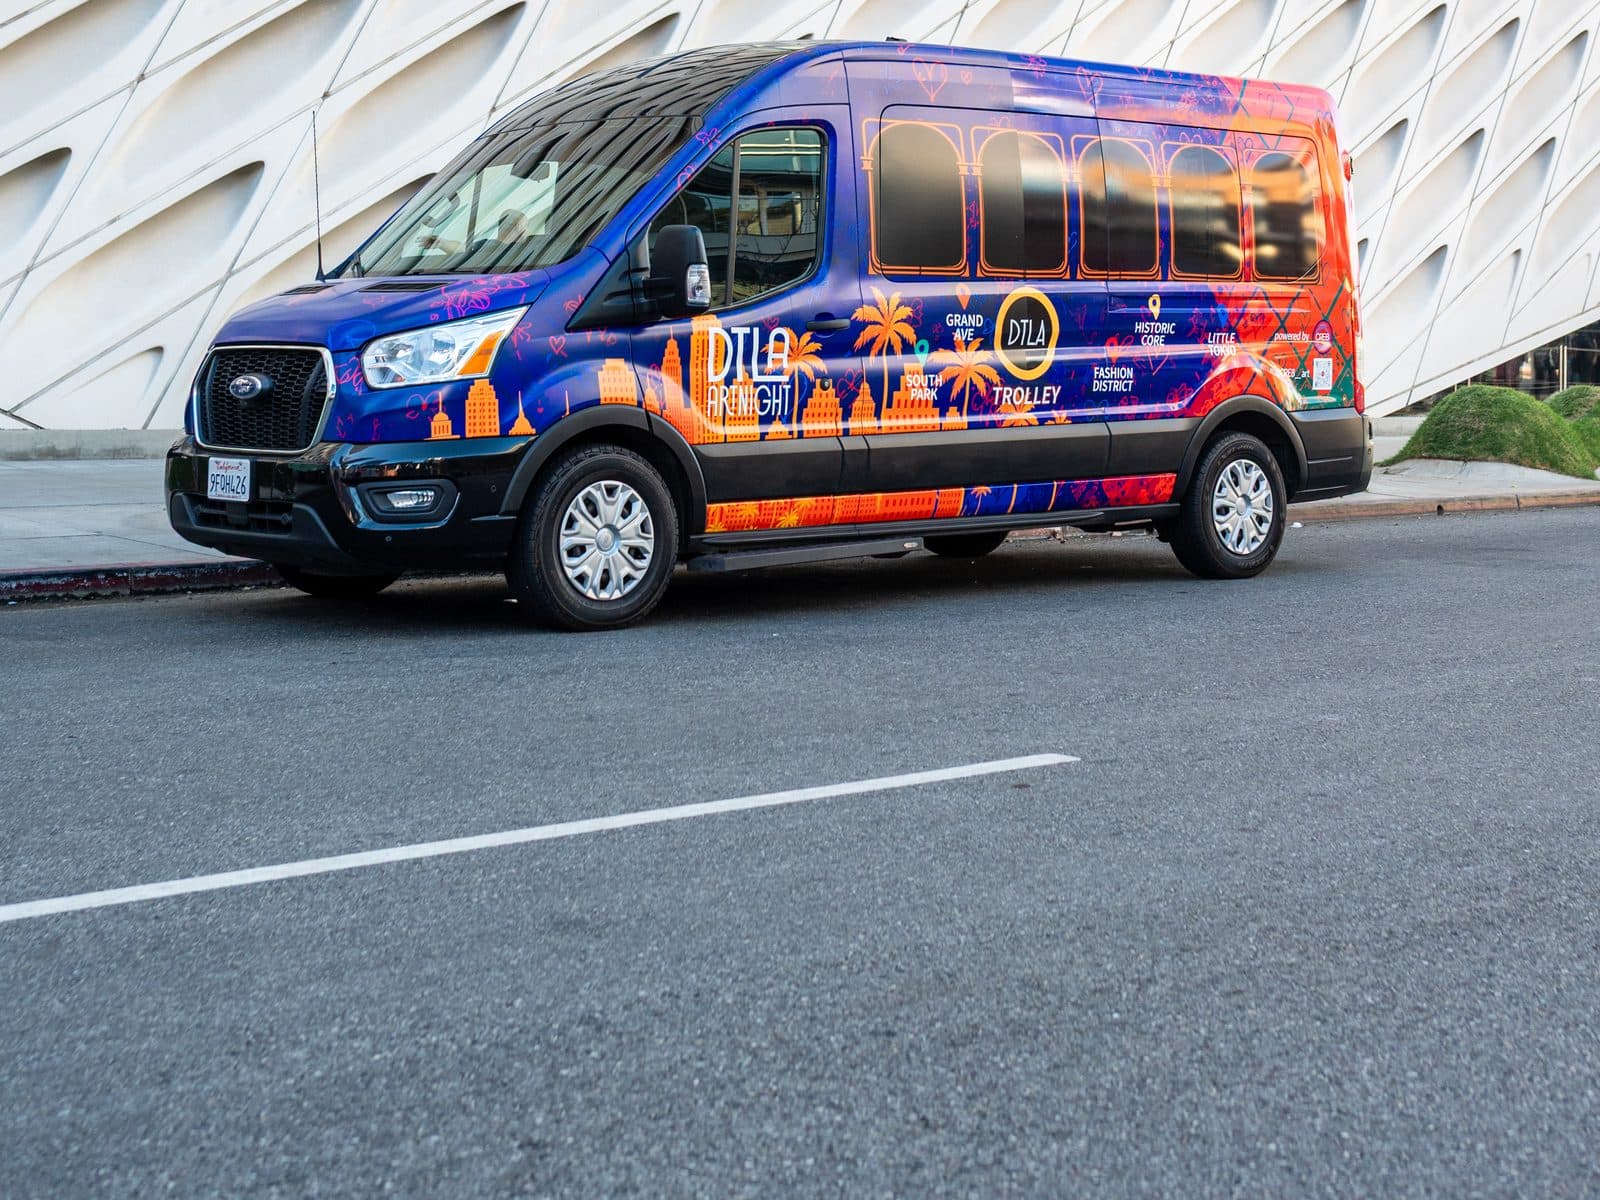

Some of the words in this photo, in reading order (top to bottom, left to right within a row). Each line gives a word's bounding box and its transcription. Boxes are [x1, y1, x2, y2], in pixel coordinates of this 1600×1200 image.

[945, 313, 984, 327] GRAND
[953, 327, 974, 341] AVE
[1007, 318, 1046, 346] DTLA
[1134, 322, 1176, 334] HISTORIC
[1140, 334, 1165, 347] CORE
[1207, 332, 1236, 343] LITTLE
[1273, 331, 1301, 342] powered
[1302, 331, 1310, 342] by
[707, 326, 790, 383] DTLA
[1207, 344, 1236, 357] TOKYO
[1093, 367, 1134, 379] FASHION
[906, 374, 943, 388] SOUTH
[1092, 380, 1134, 392] DISTRICT
[707, 384, 791, 417] ARTNIGHT
[910, 387, 938, 401] PARK
[993, 385, 1061, 407] TROLLEY
